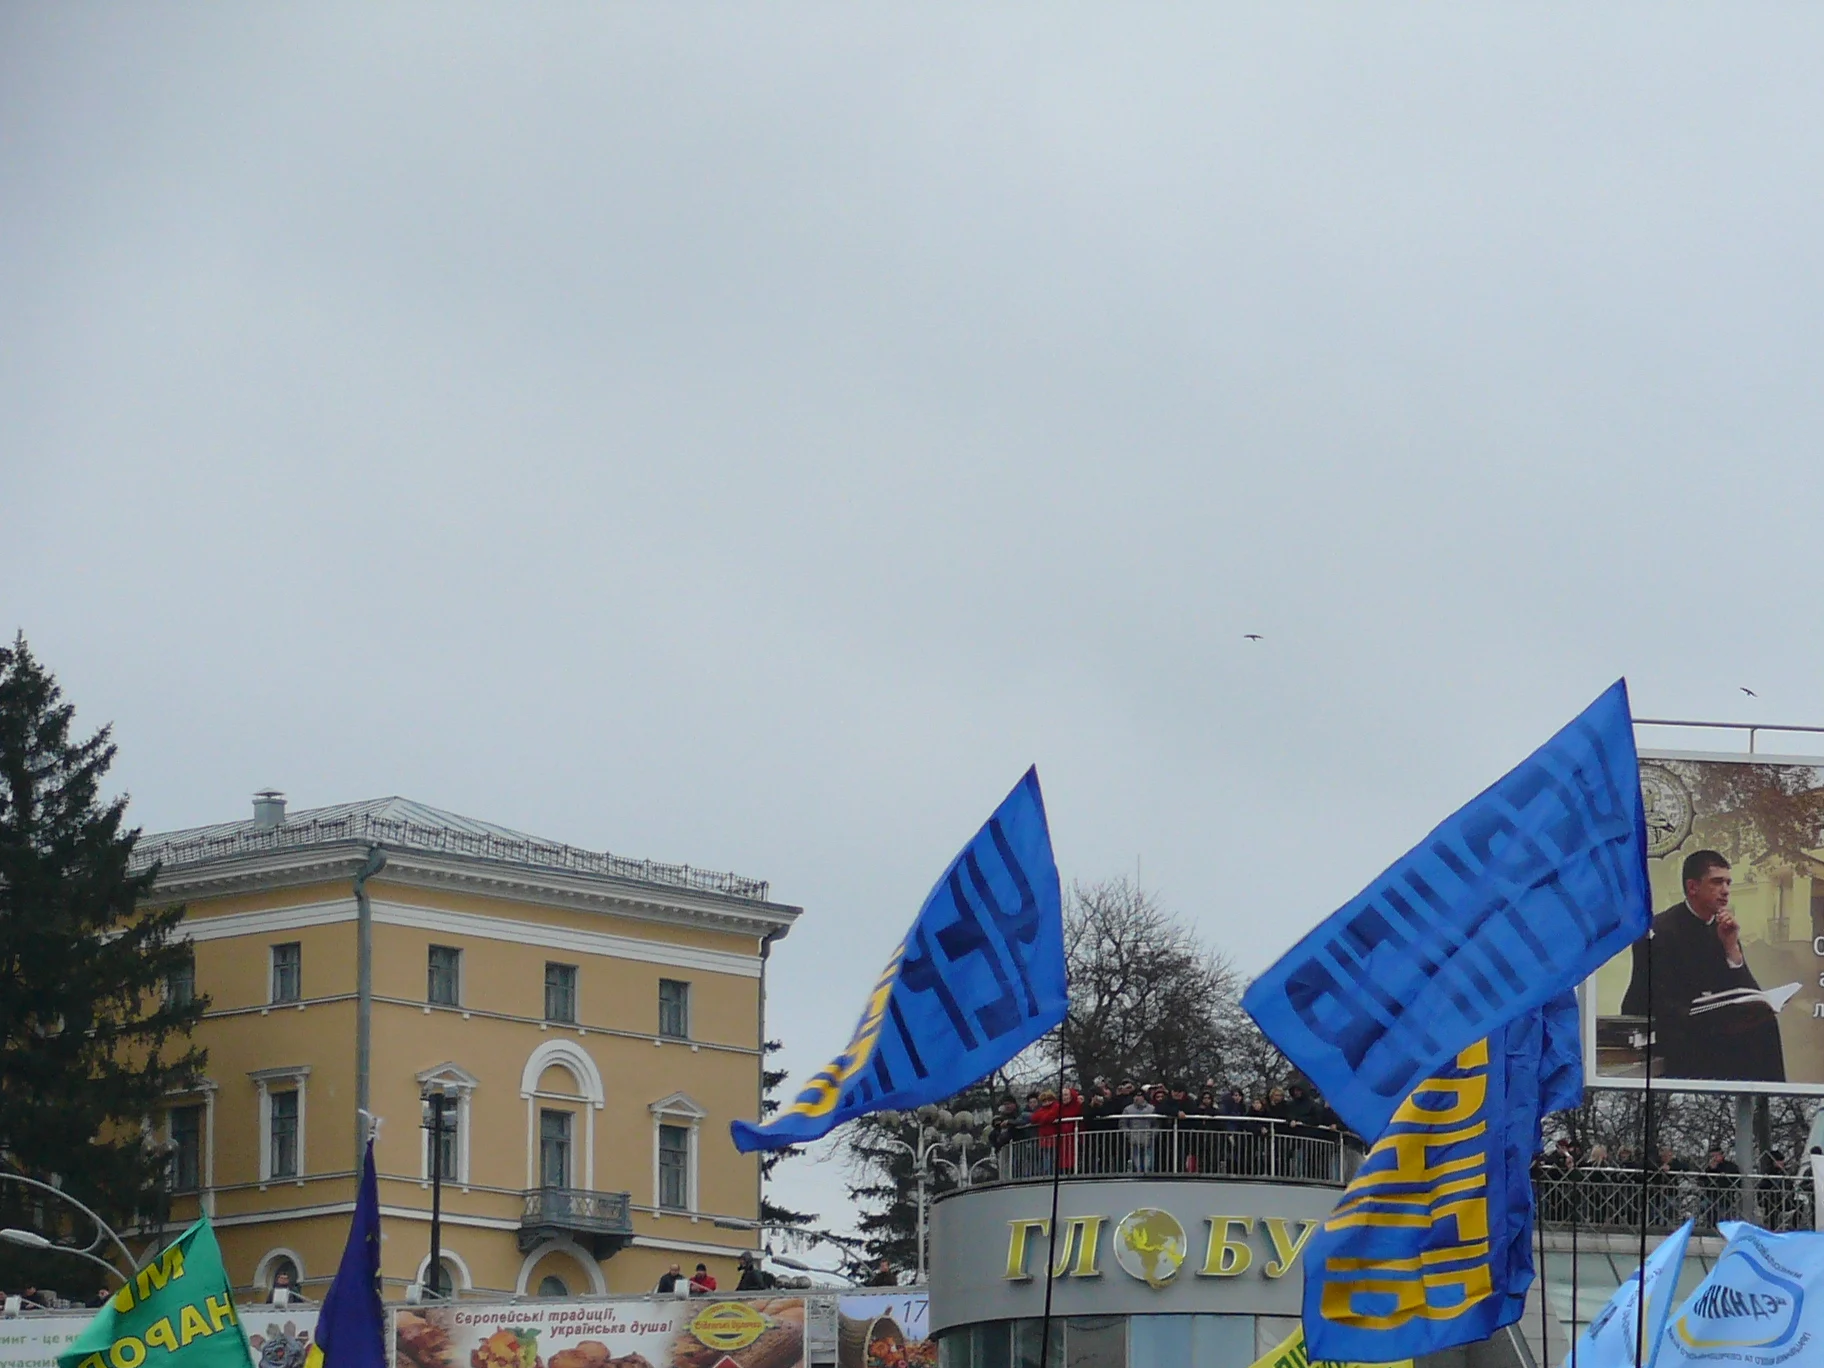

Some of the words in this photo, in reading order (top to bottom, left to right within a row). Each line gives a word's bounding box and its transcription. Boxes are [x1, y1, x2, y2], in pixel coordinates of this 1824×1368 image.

[455, 1309, 544, 1326] Європейські
[548, 1307, 617, 1323] традиції,
[549, 1322, 626, 1338] українська
[631, 1321, 673, 1335] душа!
